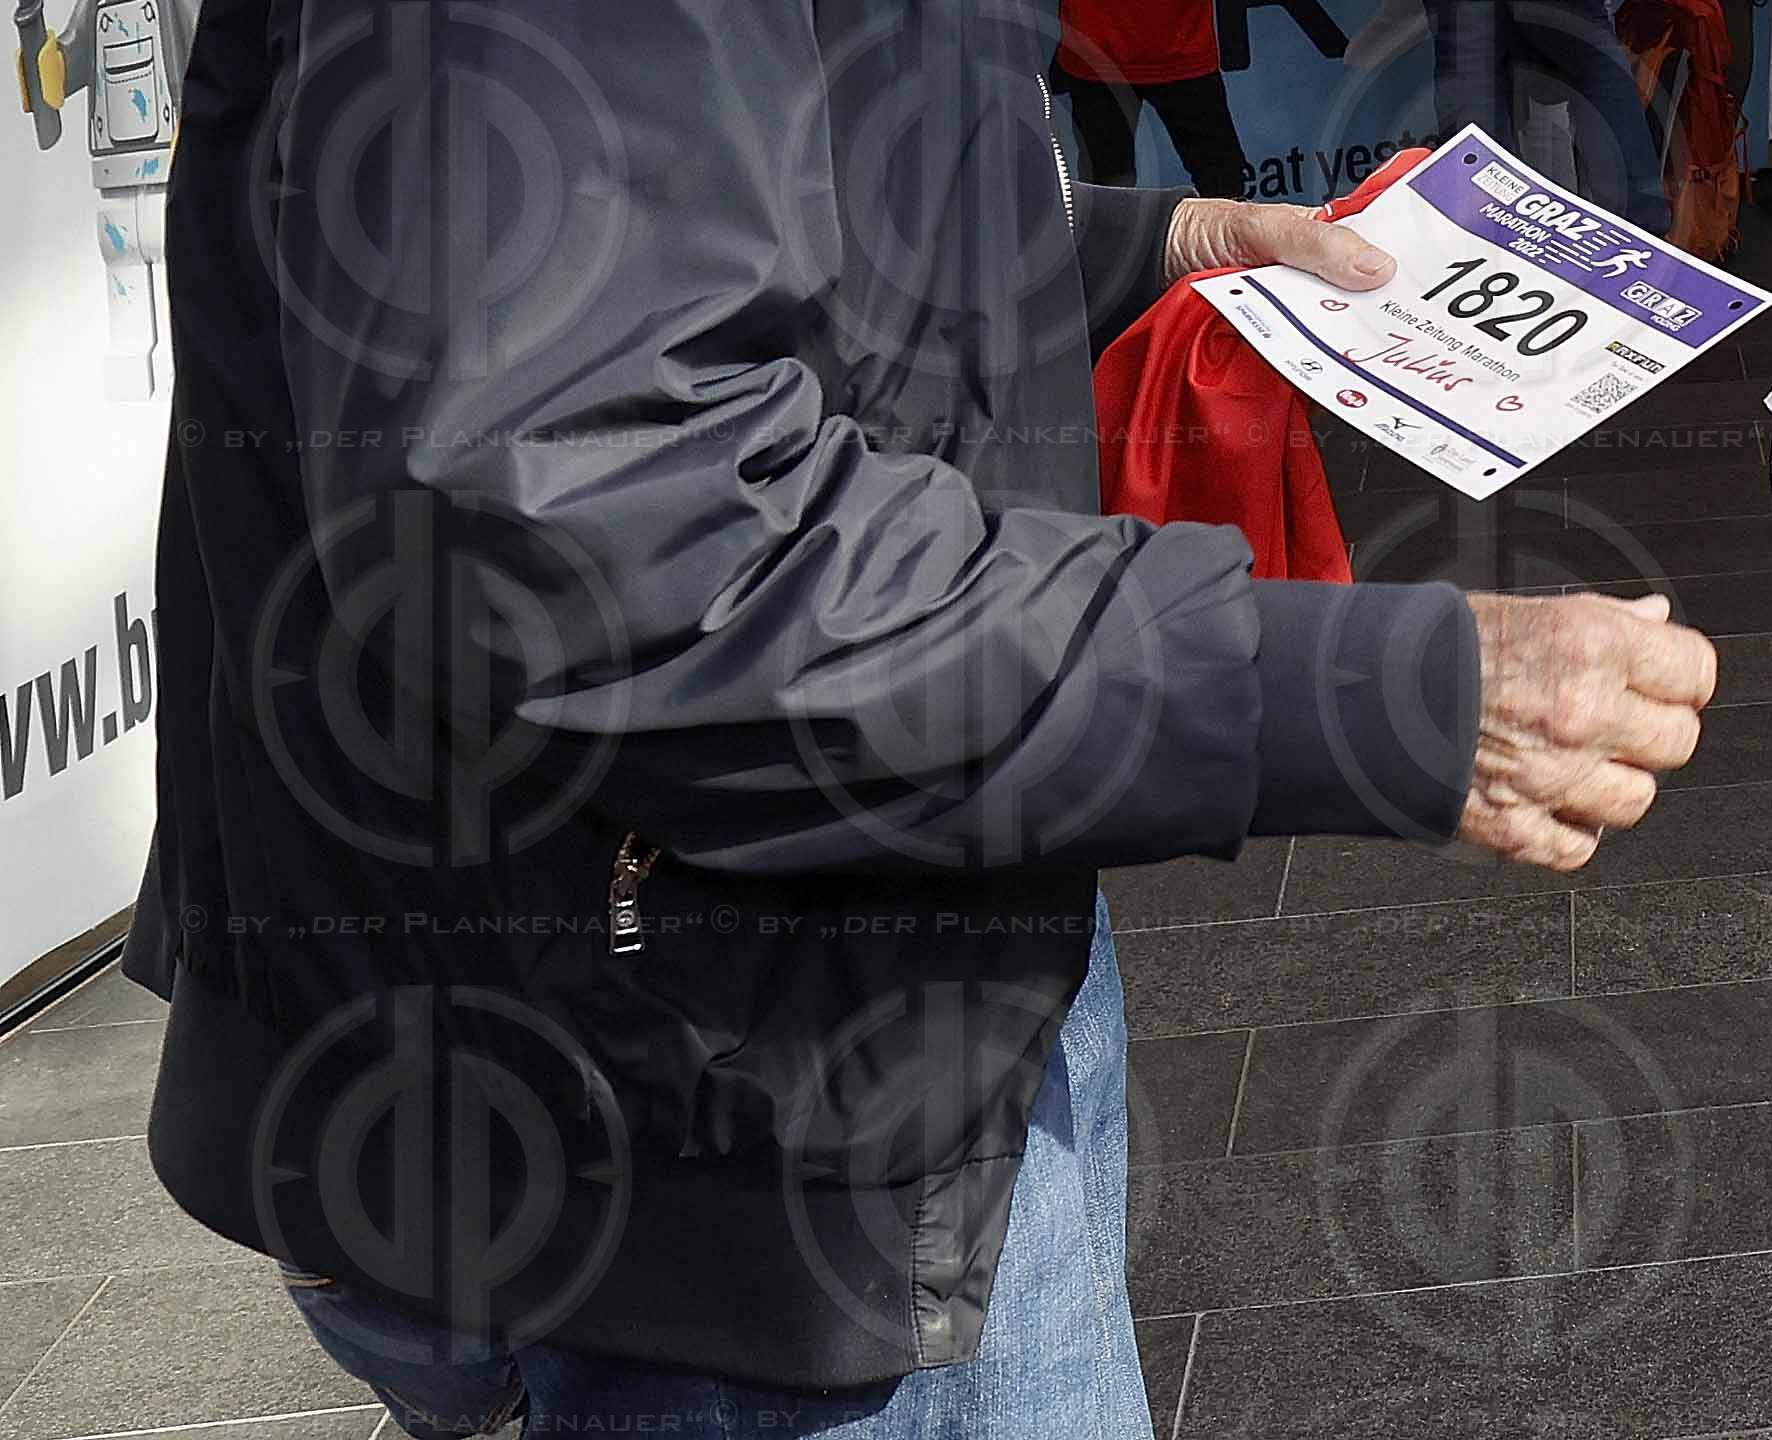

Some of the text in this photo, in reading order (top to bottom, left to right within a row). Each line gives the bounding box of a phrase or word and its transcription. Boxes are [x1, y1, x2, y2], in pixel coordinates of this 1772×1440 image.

[1487, 166, 1525, 195] KLEINE
[1480, 203, 1551, 244] MARATHON
[1515, 193, 1602, 240] GRAZ
[1509, 237, 1544, 258] 2022
[1421, 257, 1588, 357] 1820
[1625, 284, 1698, 324] GRAZ
[1343, 332, 1474, 391] Julius
[1379, 300, 1522, 383] Kleine Zeitung Marathon
